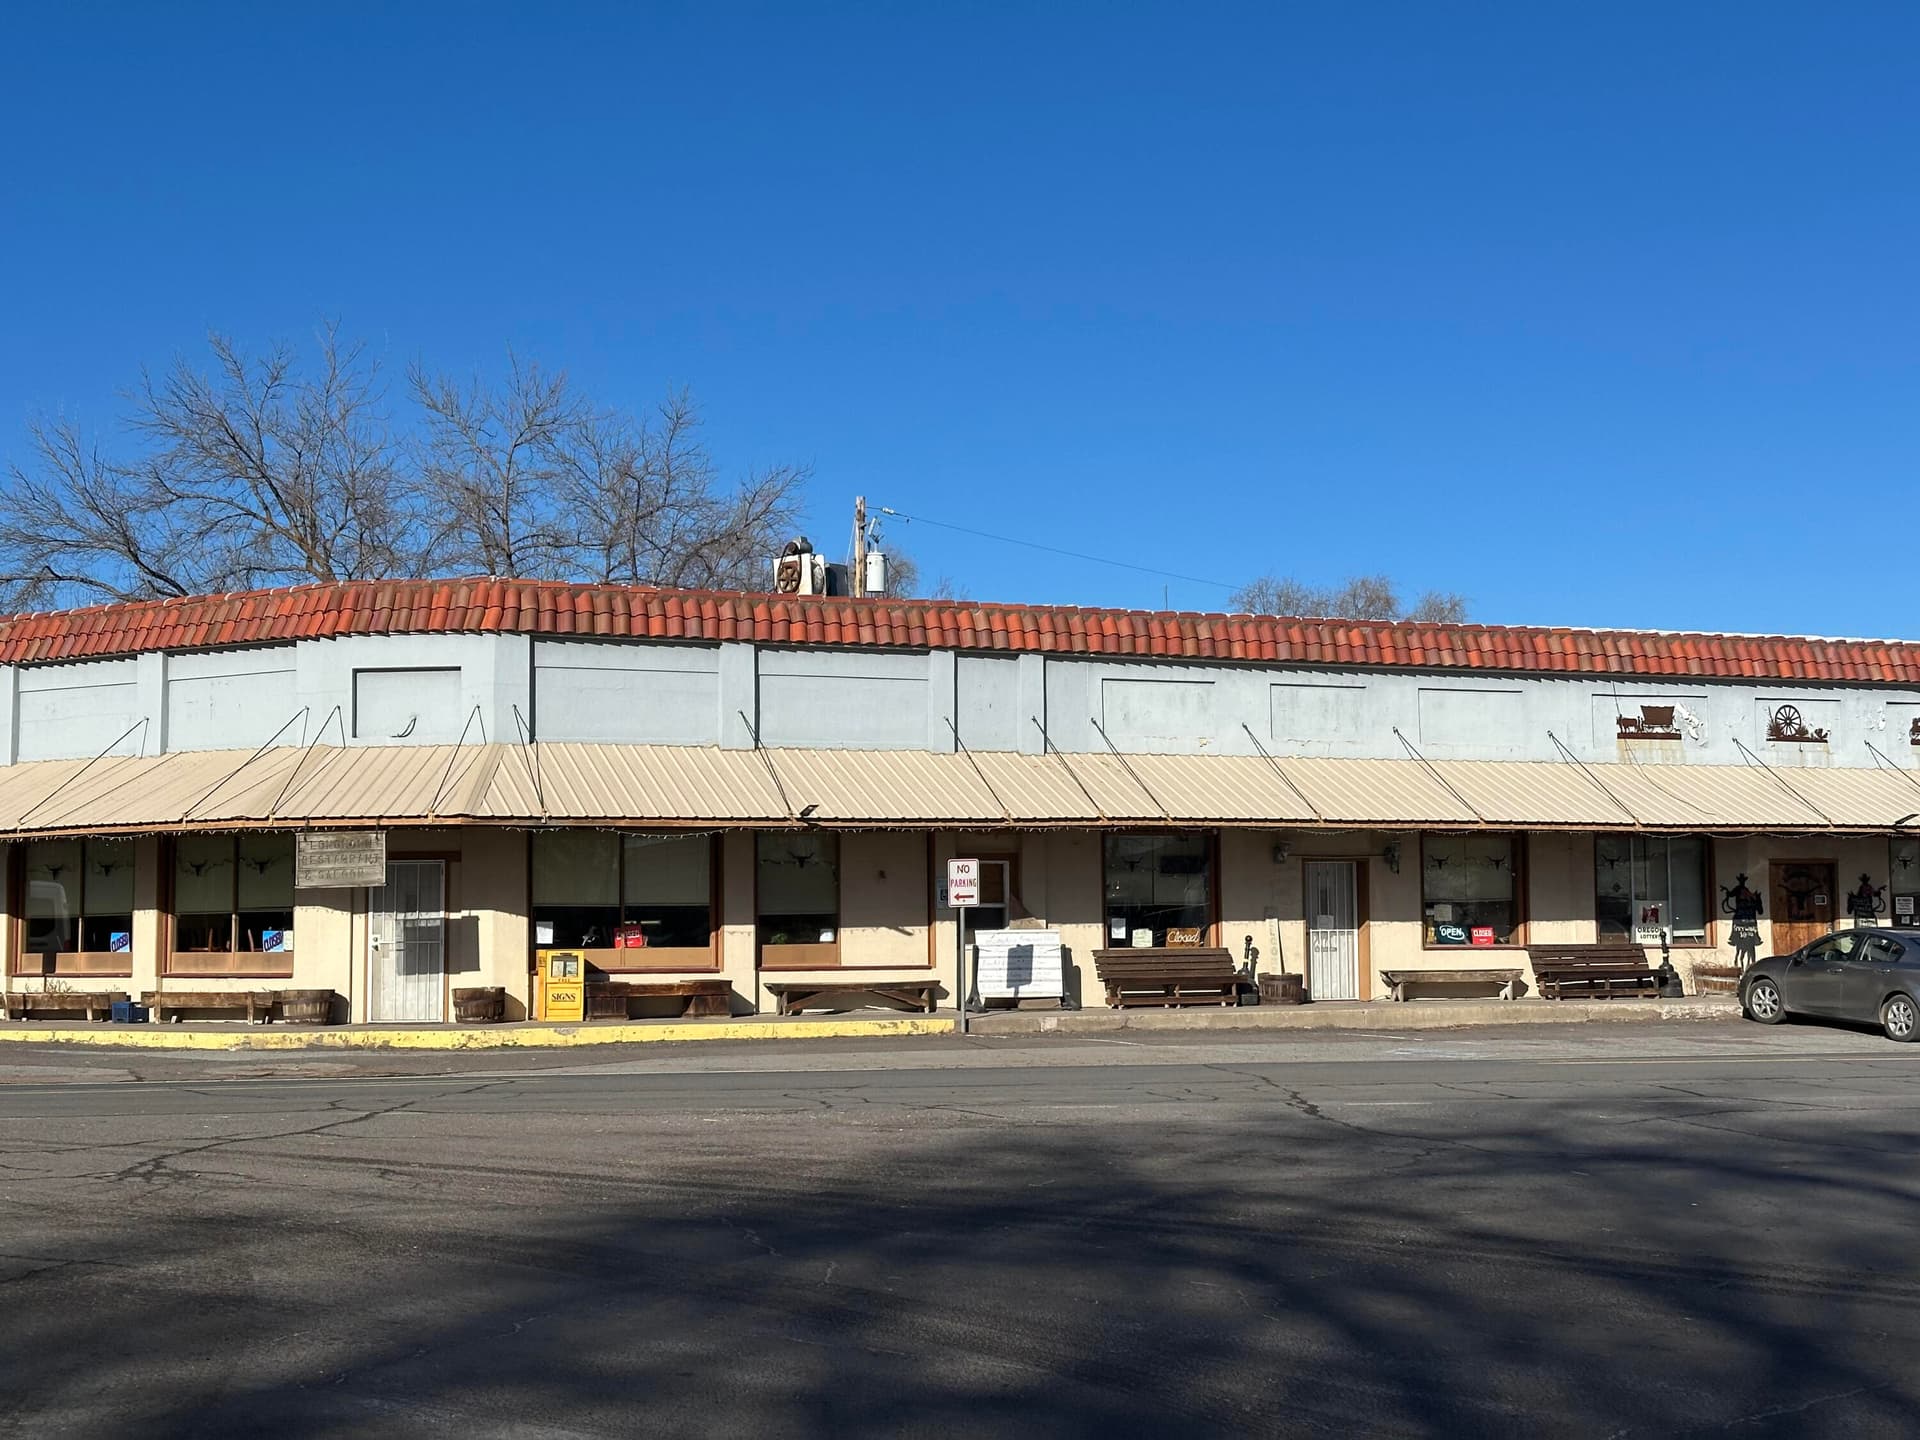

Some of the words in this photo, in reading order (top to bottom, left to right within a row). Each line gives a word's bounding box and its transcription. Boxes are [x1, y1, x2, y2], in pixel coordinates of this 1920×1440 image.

[956, 864, 970, 874] NO
[950, 878, 977, 888] PARKING
[1440, 927, 1462, 938] OPEN
[1473, 929, 1492, 937] CLOSED
[1637, 926, 1664, 934] OREGON
[264, 931, 283, 951] CLOSED
[1167, 930, 1200, 943] Closed
[112, 933, 129, 951] CLOSED
[551, 993, 576, 1001] SIGNS
